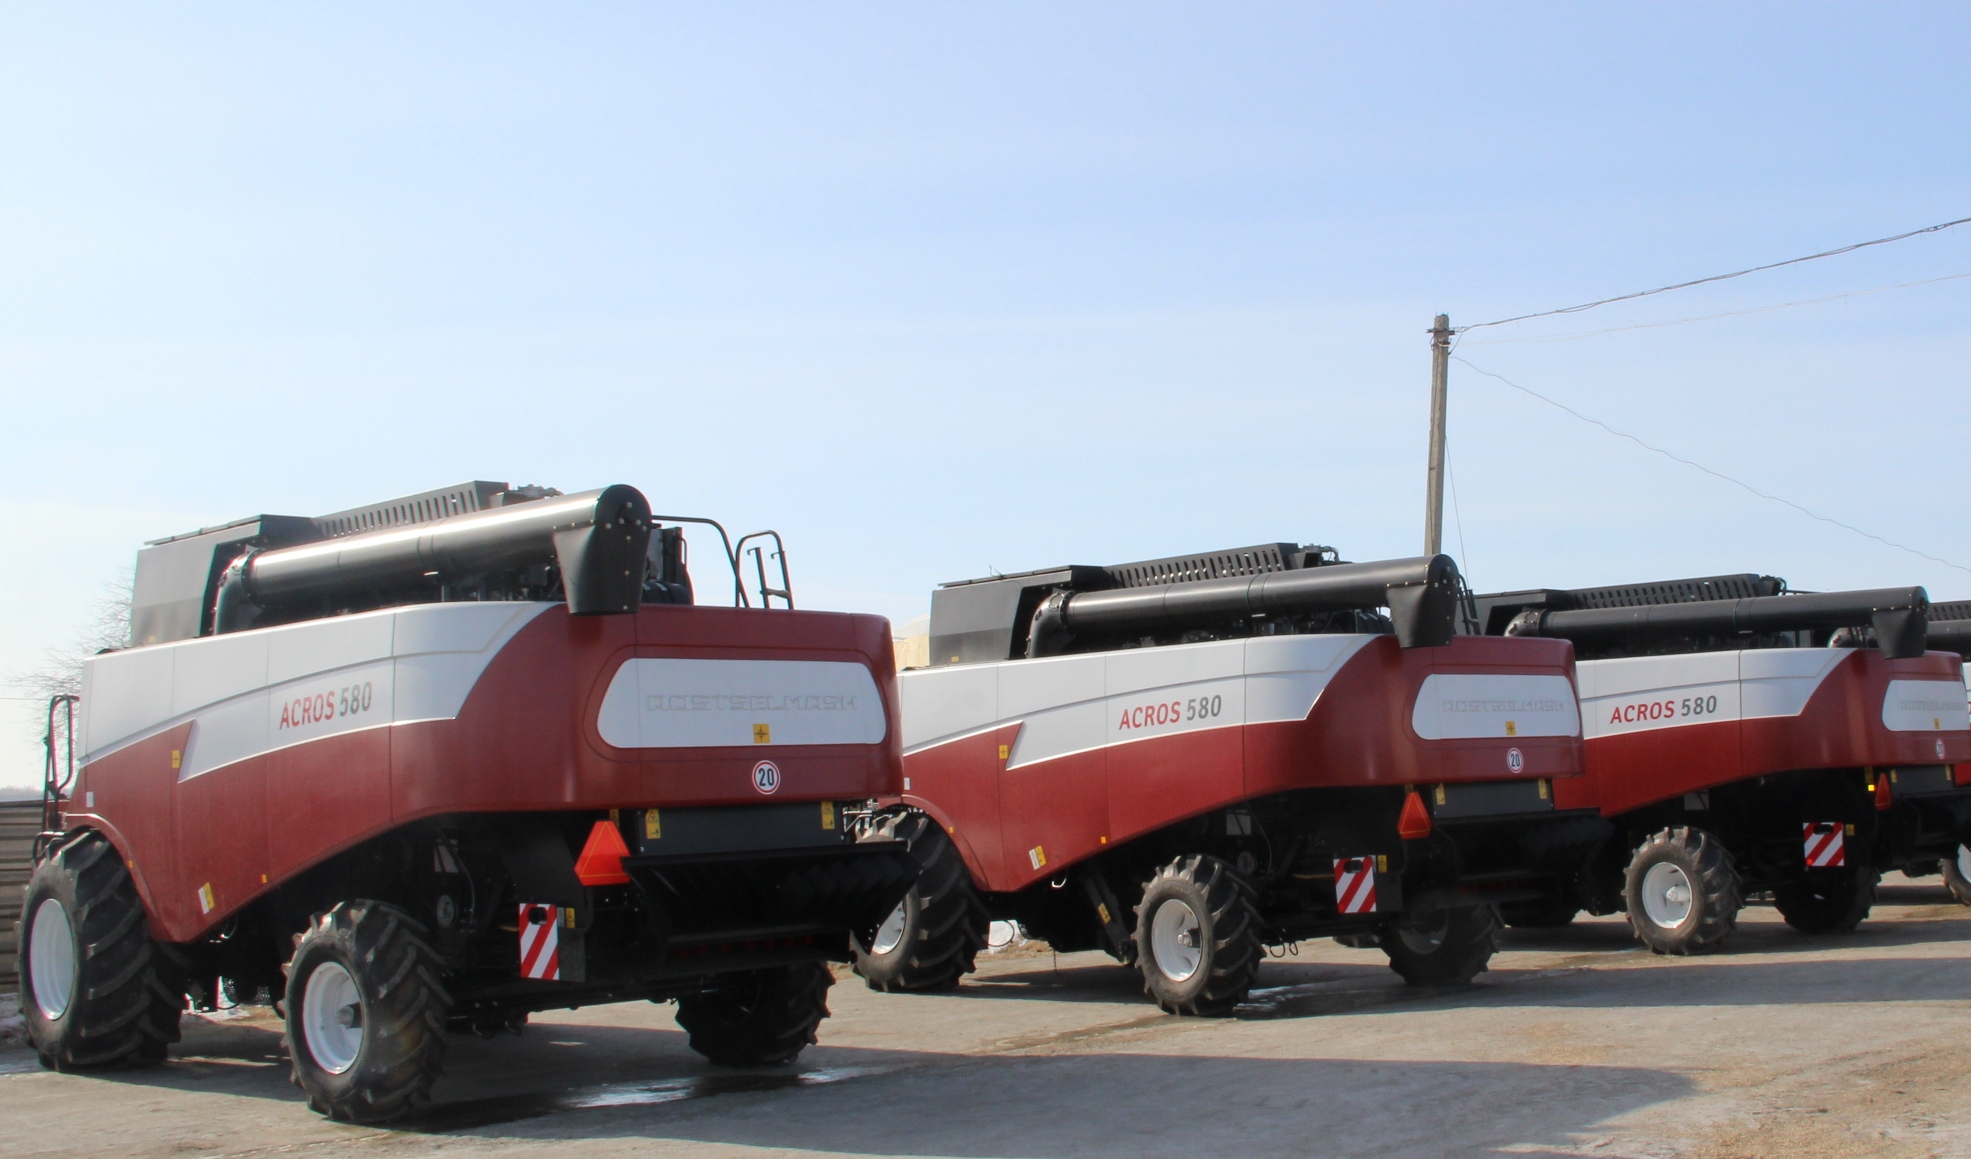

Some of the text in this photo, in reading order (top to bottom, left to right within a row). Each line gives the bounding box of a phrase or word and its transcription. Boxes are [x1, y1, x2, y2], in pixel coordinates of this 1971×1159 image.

[279, 681, 372, 730] ACROS 580
[647, 694, 859, 712] ROSTSELMASH
[1119, 694, 1222, 730] ACROS 580
[1610, 695, 1717, 724] ACROS 580
[1510, 753, 1521, 767] 20
[757, 767, 775, 787] 20
